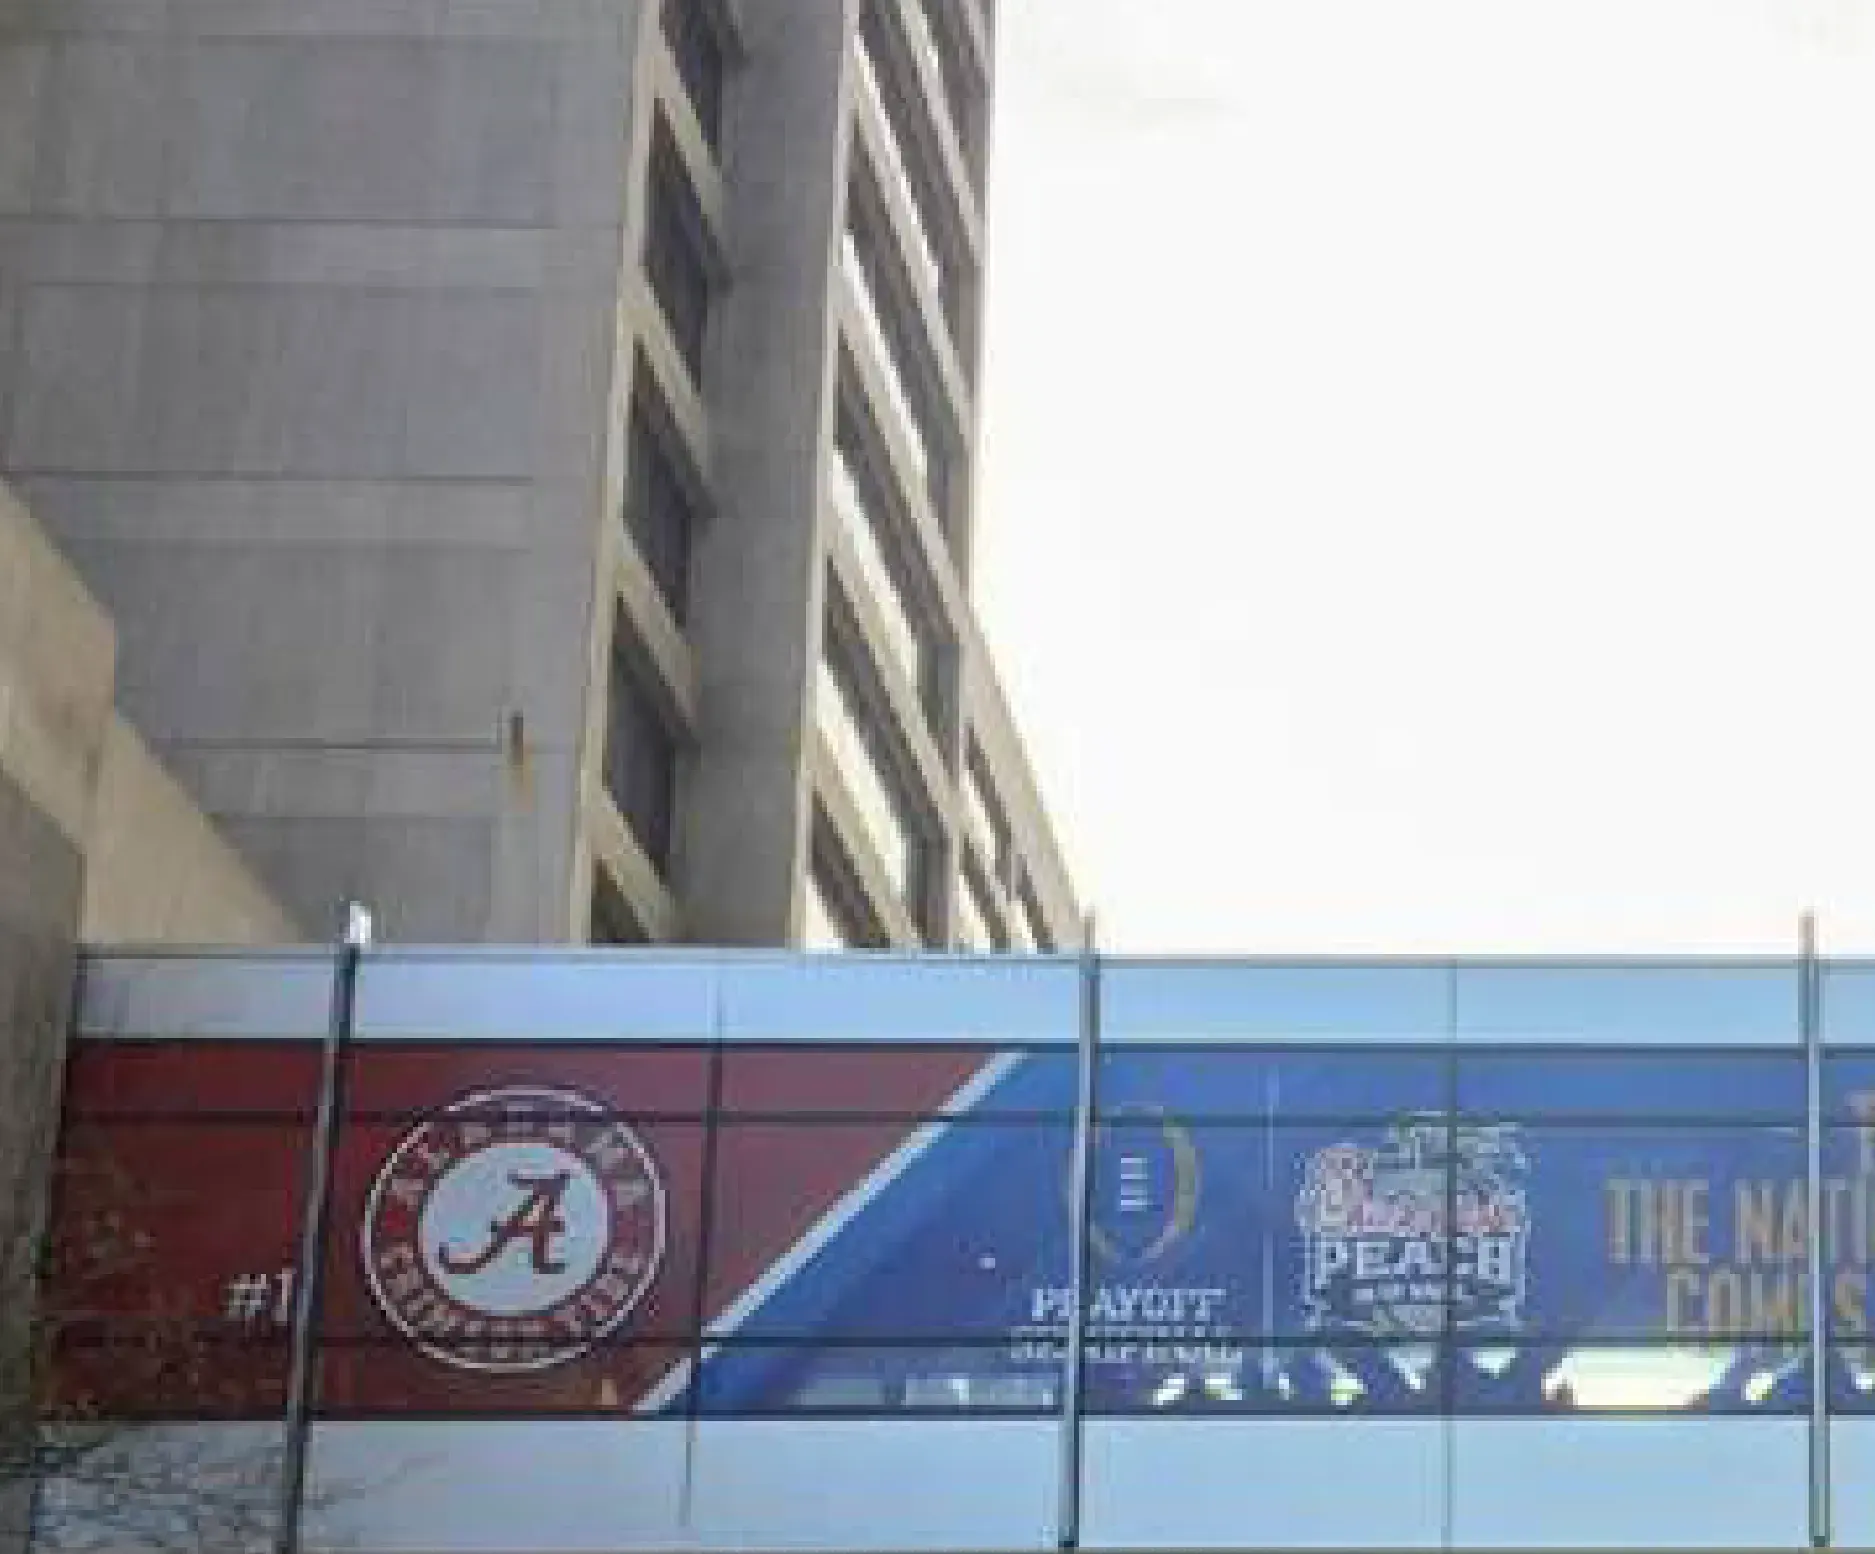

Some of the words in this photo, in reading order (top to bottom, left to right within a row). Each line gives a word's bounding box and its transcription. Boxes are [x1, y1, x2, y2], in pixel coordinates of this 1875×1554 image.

[439, 1172, 569, 1273] A
[1606, 1178, 1710, 1264] THE
[226, 1270, 293, 1326] #1
